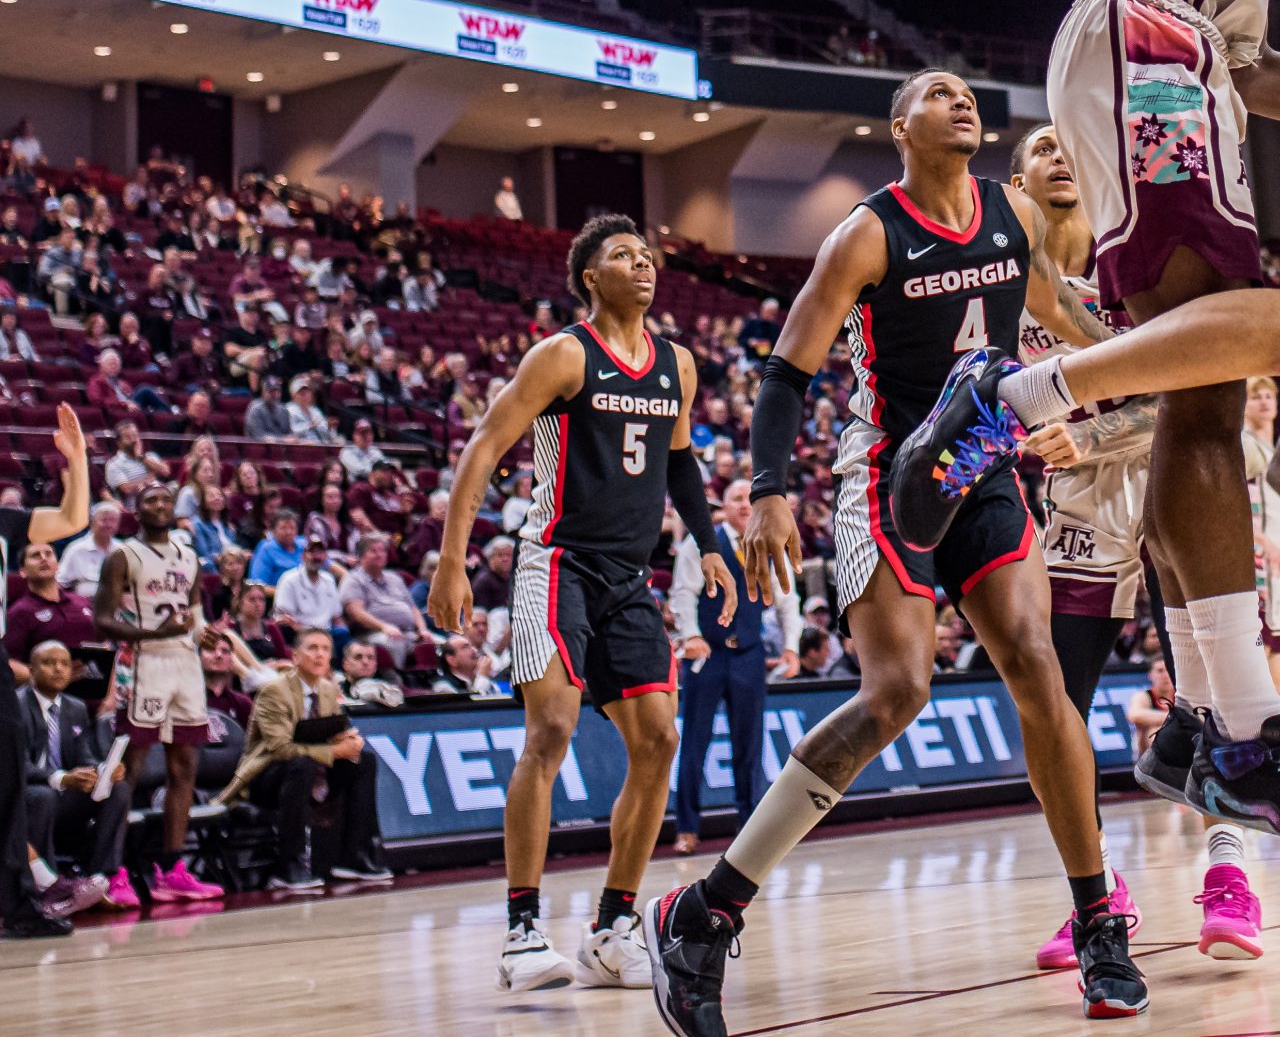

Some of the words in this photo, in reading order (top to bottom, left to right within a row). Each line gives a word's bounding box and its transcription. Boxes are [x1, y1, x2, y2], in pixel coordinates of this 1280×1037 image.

[459, 12, 525, 40] WTAW
[903, 258, 1021, 299] GEORGIA
[954, 296, 989, 353] 4
[592, 393, 679, 417] GEORGIA
[623, 423, 649, 475] 5
